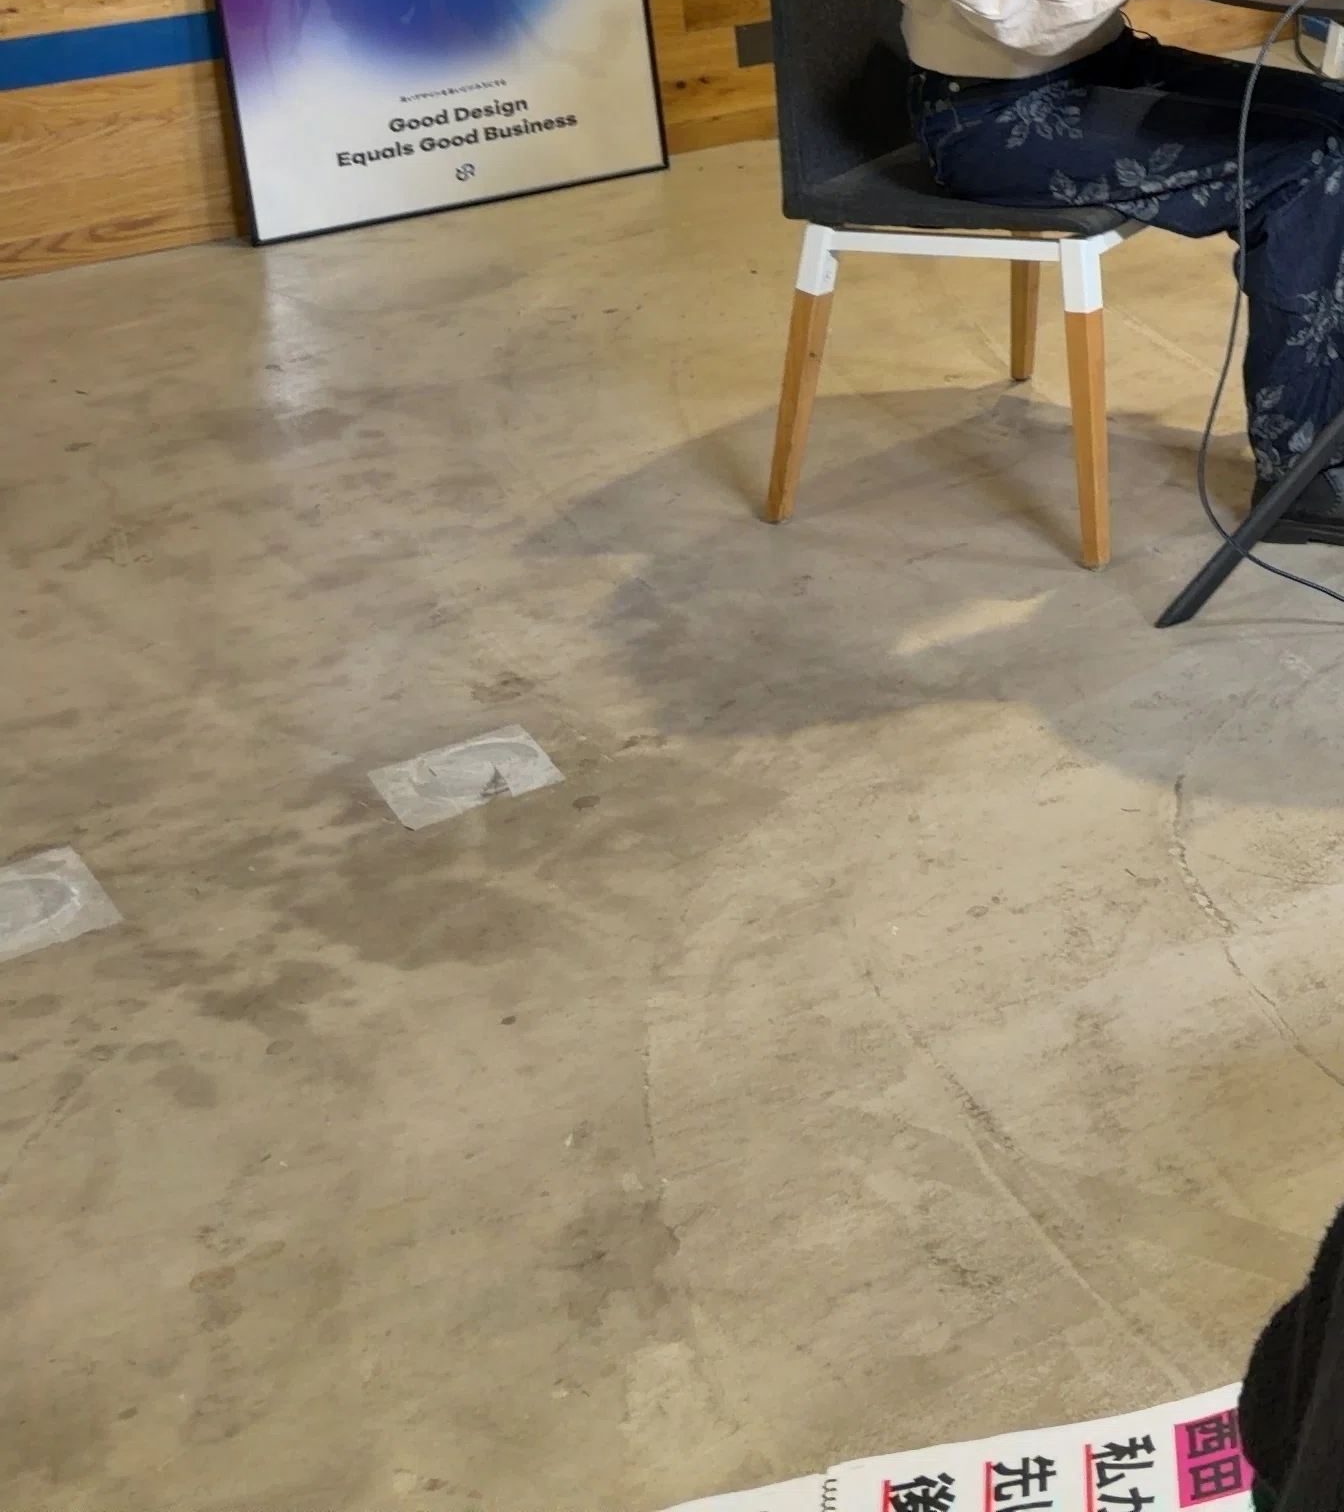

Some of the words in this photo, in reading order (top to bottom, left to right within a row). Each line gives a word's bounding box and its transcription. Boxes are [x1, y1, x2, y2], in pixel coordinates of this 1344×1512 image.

[336, 141, 415, 167] Equals
[419, 128, 479, 153] Good
[483, 113, 579, 142] Business
[388, 109, 449, 133] Good
[454, 98, 529, 123] Design
[1184, 1410, 1244, 1502] 西田
[993, 1456, 1058, 1512] 先
